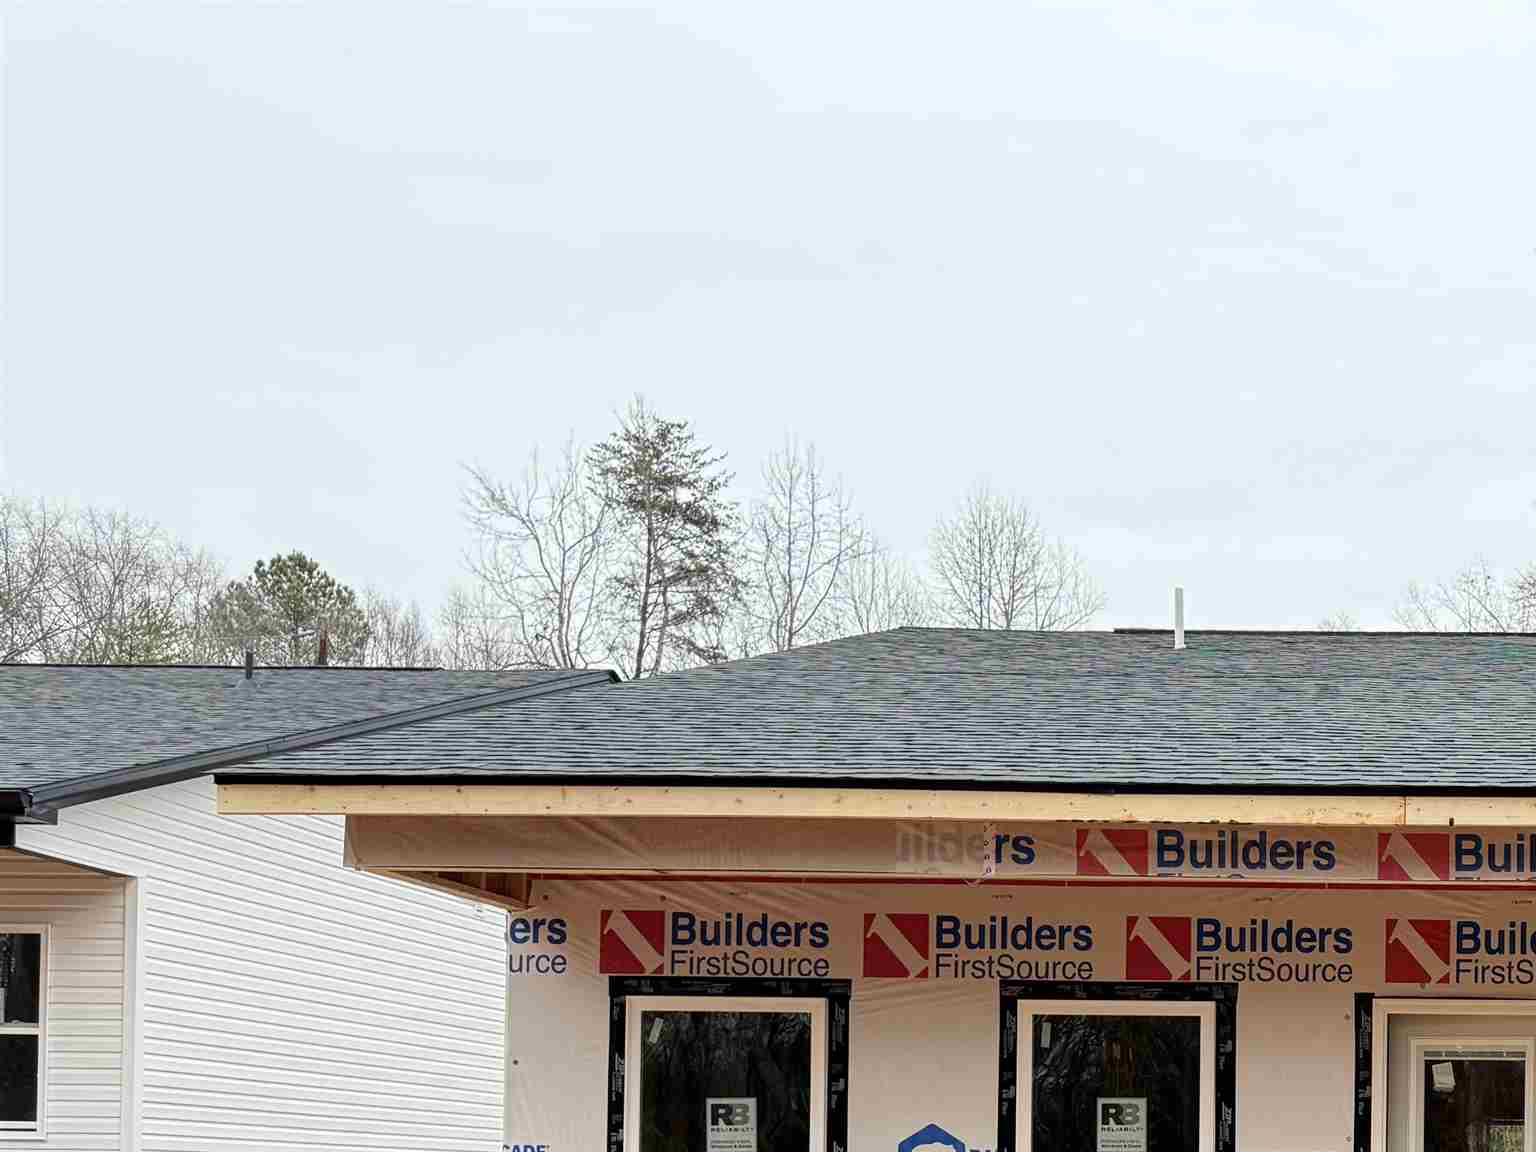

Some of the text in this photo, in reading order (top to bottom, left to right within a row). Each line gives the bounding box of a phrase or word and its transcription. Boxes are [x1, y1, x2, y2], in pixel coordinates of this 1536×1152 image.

[1156, 829, 1336, 871] Builders
[671, 914, 830, 948] Builders
[936, 916, 1094, 950] Builders
[1197, 918, 1353, 954] Builders
[671, 952, 830, 977] FirstSource
[936, 955, 1094, 980] FirstSource
[1197, 957, 1353, 983] FirstSource
